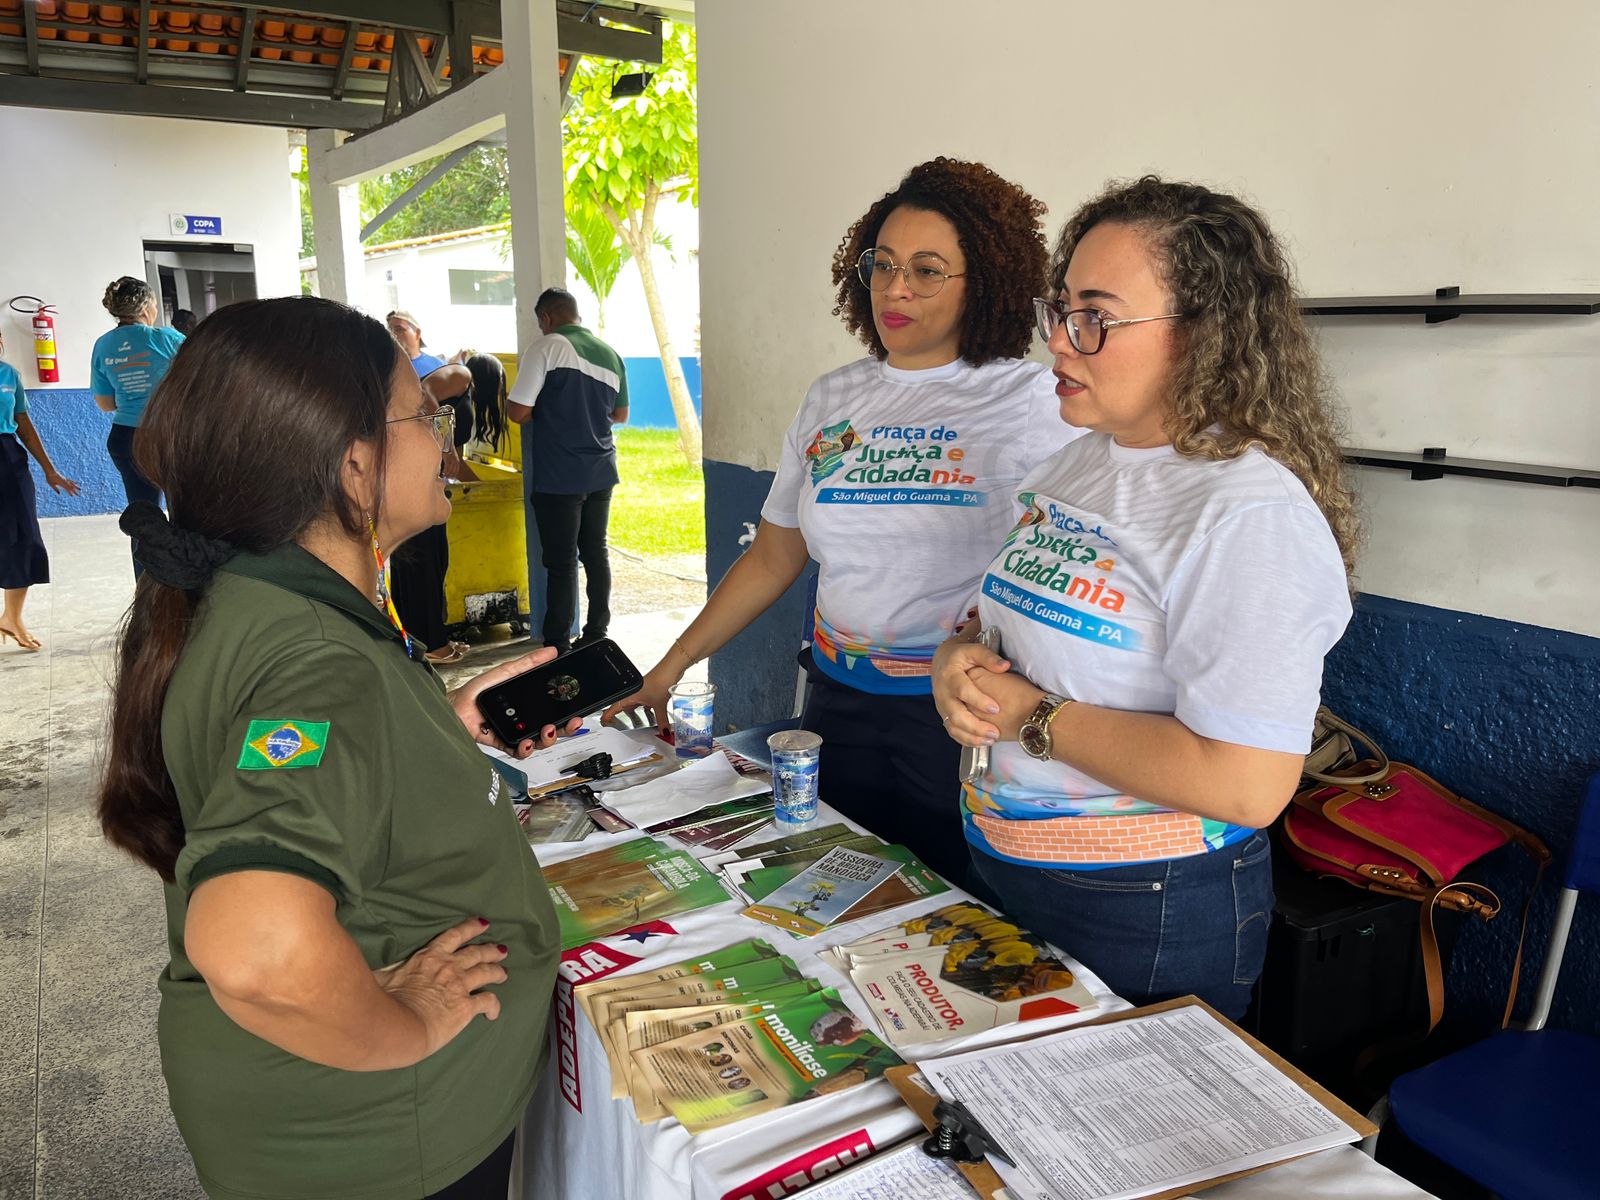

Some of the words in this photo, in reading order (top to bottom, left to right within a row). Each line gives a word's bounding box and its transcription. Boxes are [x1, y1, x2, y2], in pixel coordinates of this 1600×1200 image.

[193, 219, 215, 228] COPA
[871, 425, 926, 443] Praça
[930, 425, 958, 442] de
[947, 447, 965, 462] e
[832, 491, 851, 501] São
[853, 491, 891, 503] Miguel
[893, 491, 908, 501] do
[962, 493, 978, 504] PA
[1003, 549, 1126, 613] Cidadania
[989, 581, 1002, 596] São
[1000, 586, 1024, 607] Miguel
[1021, 597, 1034, 611] do
[1097, 625, 1123, 644] PA
[816, 863, 872, 882] MANDIOCA
[905, 963, 964, 1031] PRODUTOR,
[764, 1013, 828, 1079] monilíase
